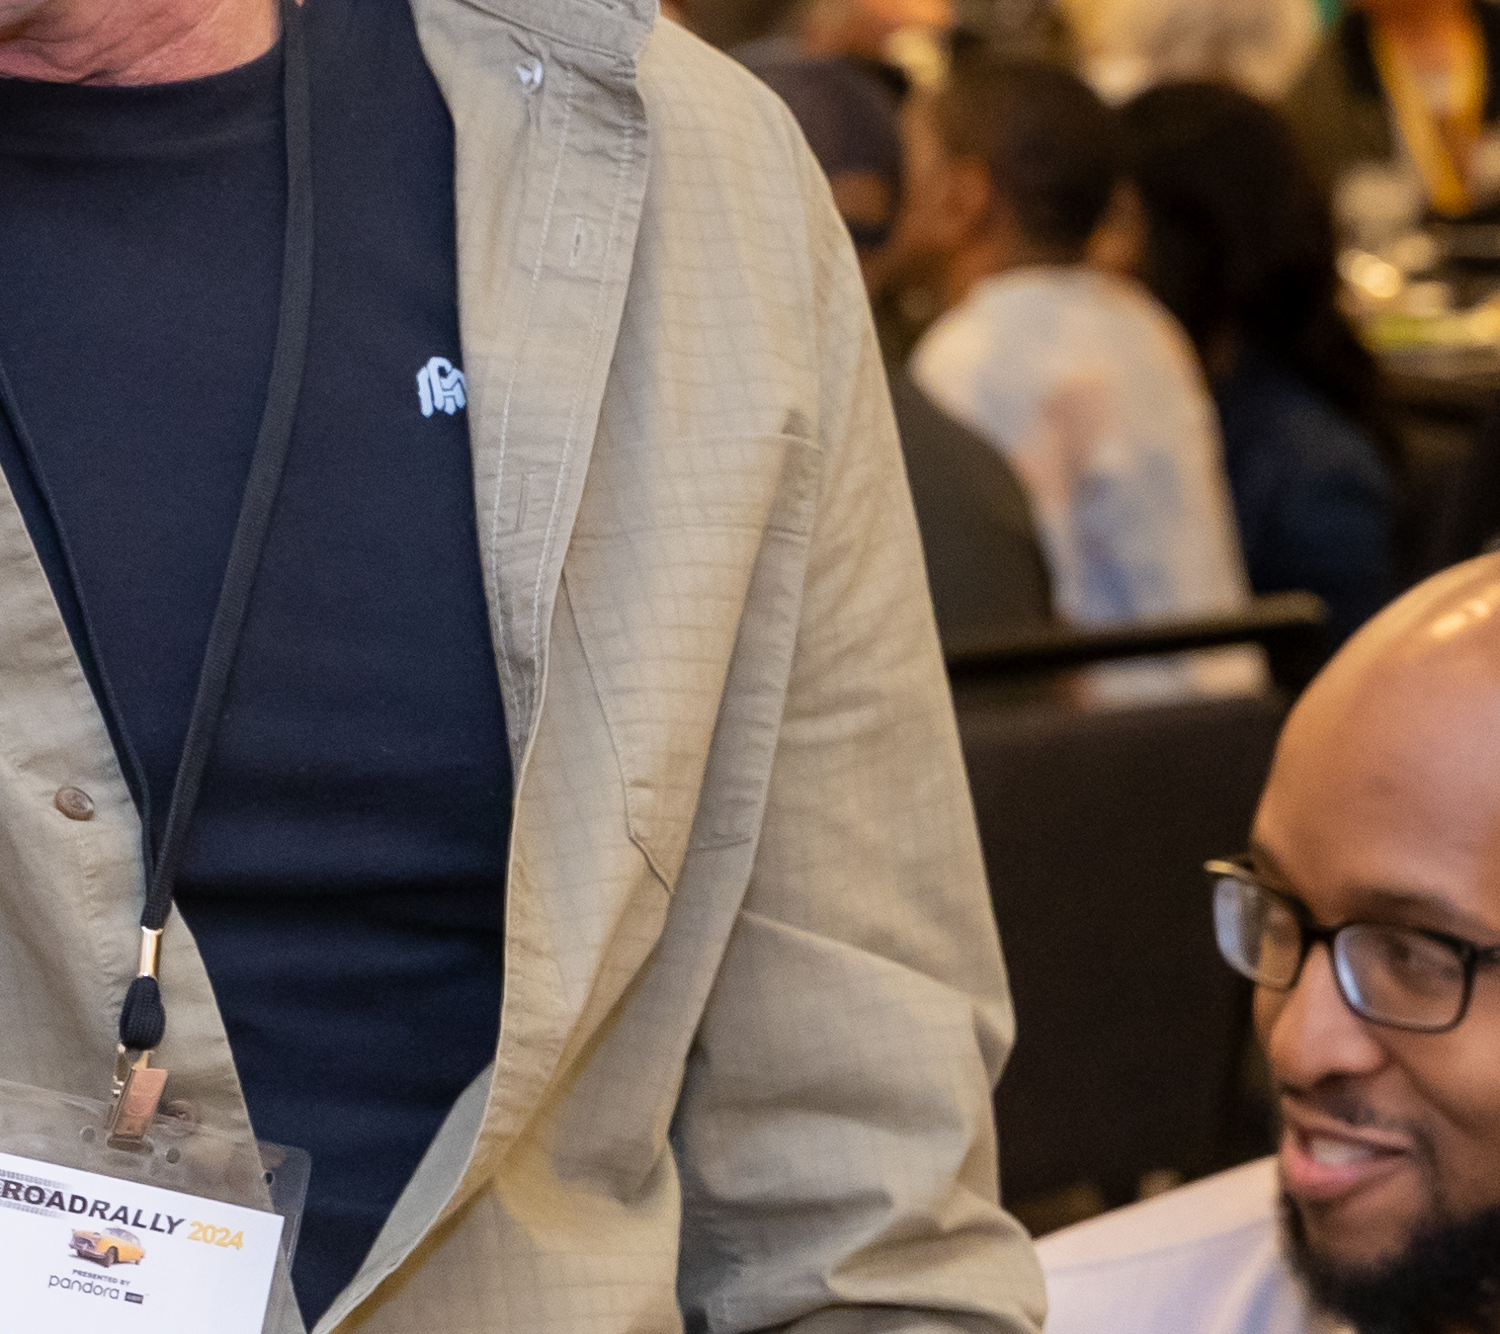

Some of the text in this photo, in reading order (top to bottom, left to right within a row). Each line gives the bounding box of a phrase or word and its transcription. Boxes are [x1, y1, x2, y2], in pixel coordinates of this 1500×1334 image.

[1, 1179, 244, 1251] ROADRALLY 2024
[48, 1274, 120, 1300] pandora
